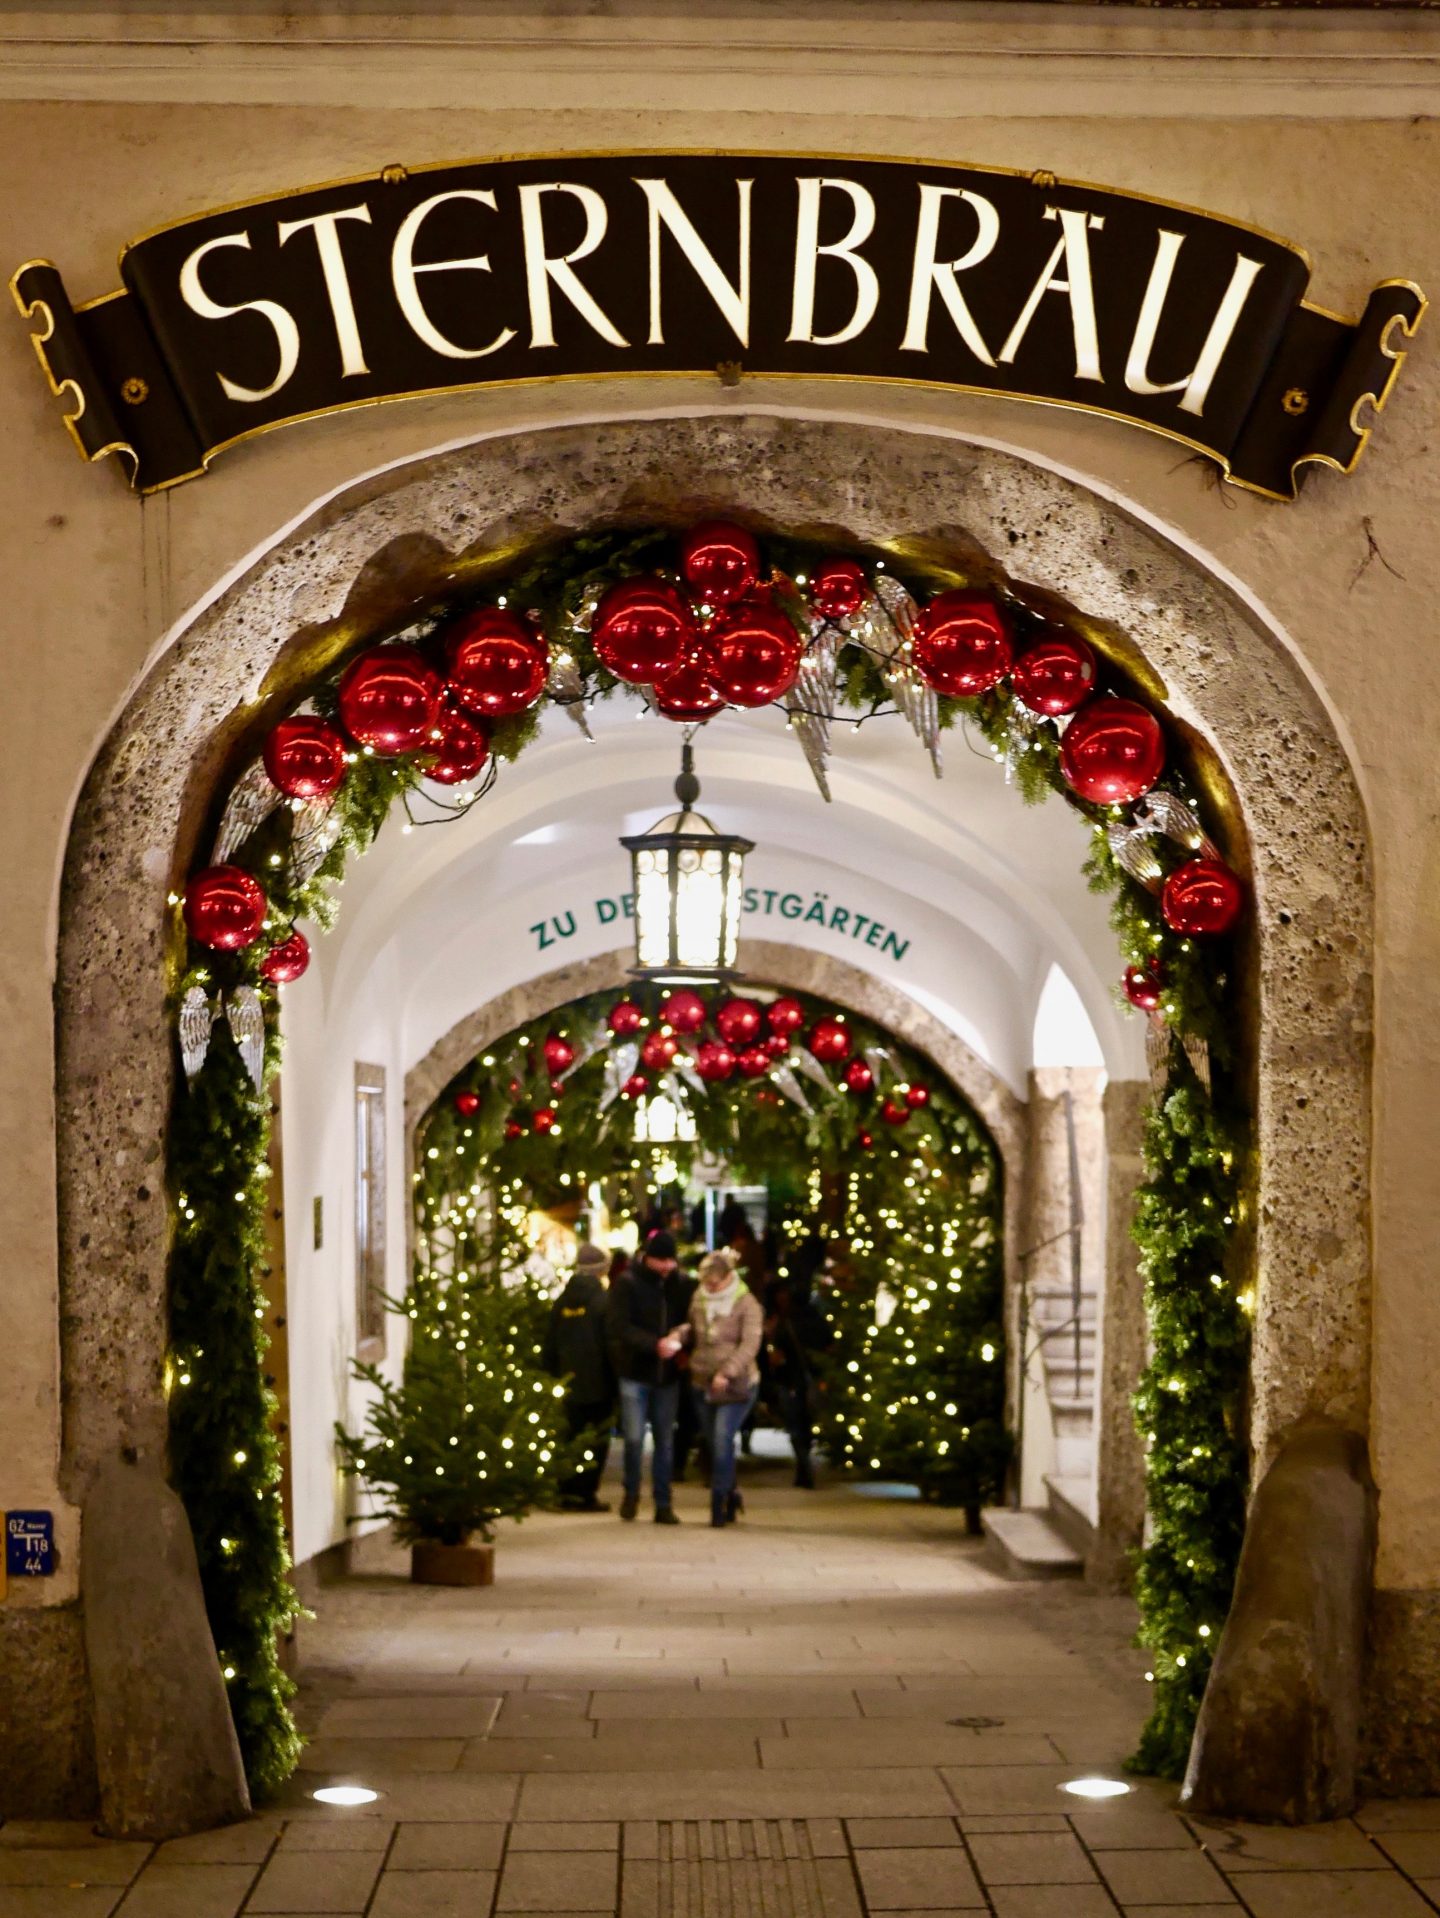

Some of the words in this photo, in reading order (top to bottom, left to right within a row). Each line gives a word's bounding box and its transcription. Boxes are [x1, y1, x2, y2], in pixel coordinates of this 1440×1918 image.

[179, 176, 1264, 413] STERNBRÄU
[529, 911, 577, 951] ZU
[595, 893, 635, 925] DE
[743, 888, 911, 961] STGÄRTEN
